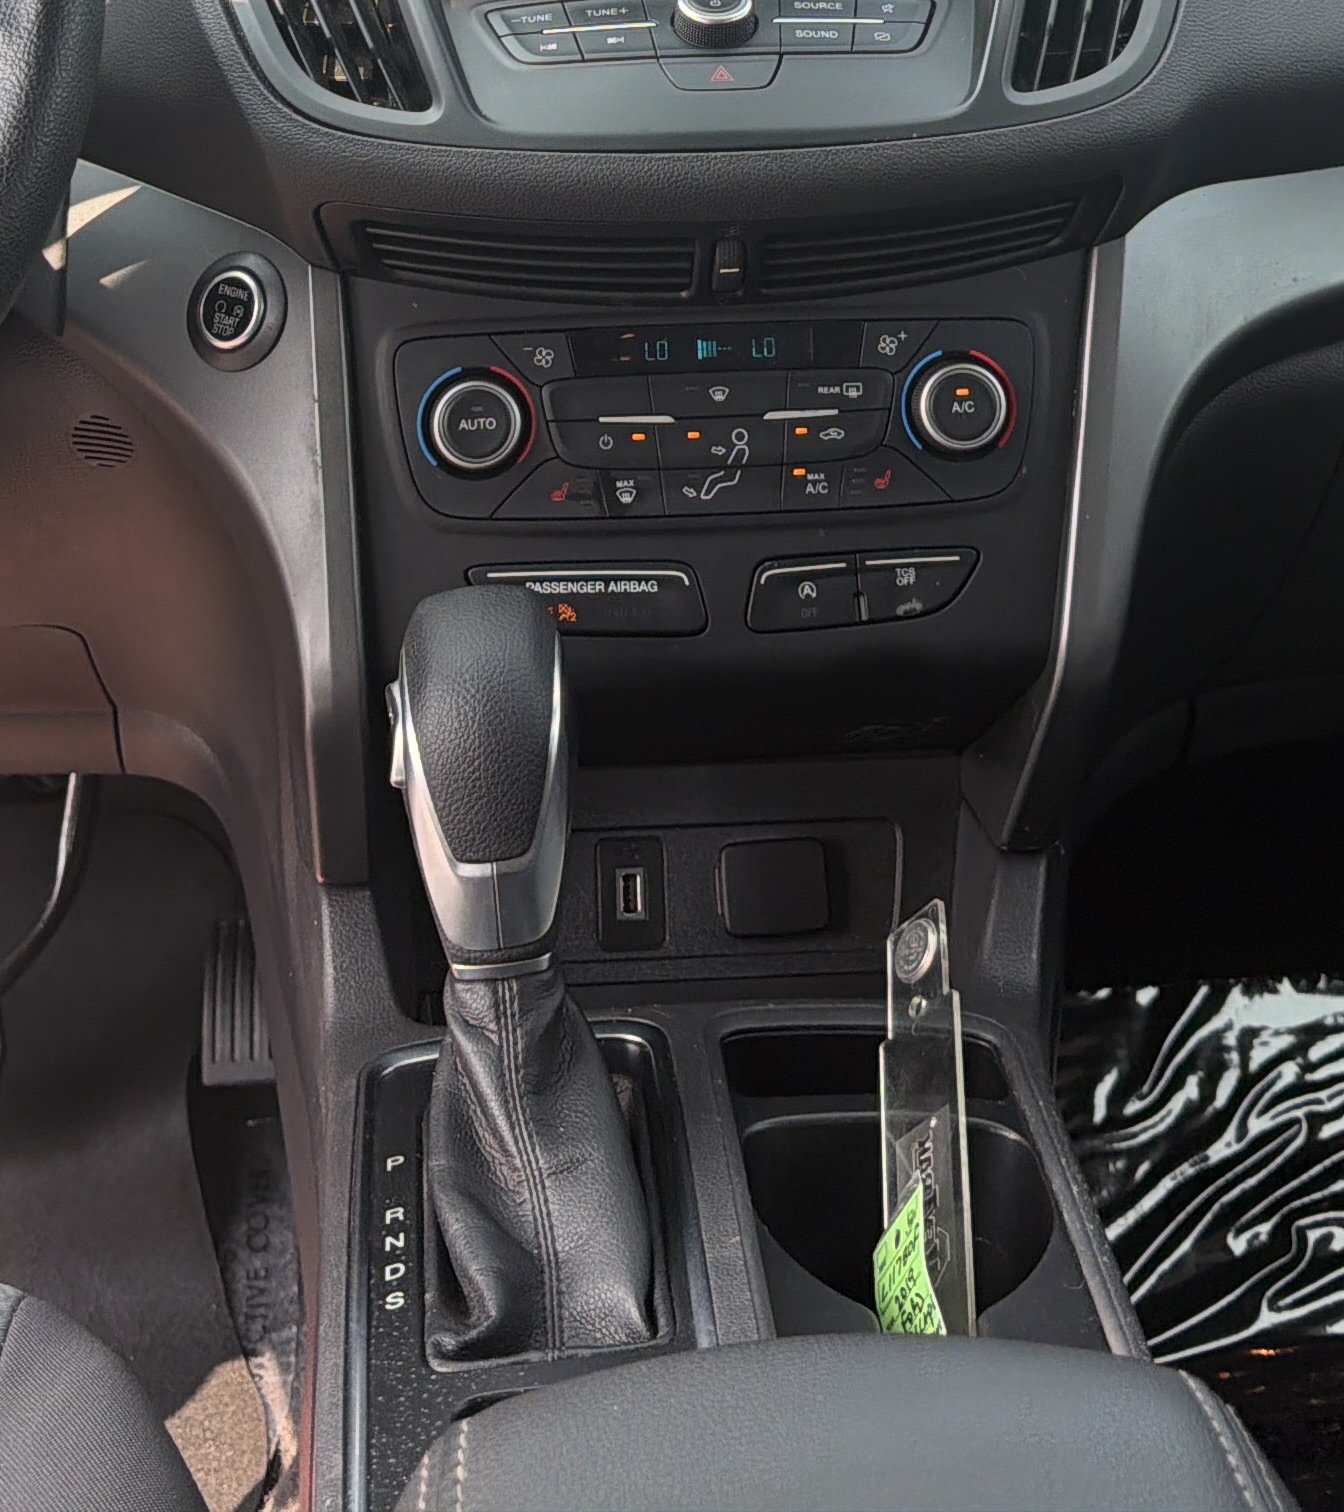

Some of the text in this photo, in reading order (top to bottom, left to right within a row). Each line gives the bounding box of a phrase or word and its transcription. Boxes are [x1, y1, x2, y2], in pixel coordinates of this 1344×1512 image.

[794, 1, 843, 10] SOURCE
[795, 29, 839, 39] SOUND
[218, 283, 249, 302] ENGINE
[213, 312, 240, 327] START
[212, 324, 235, 336] STOP
[818, 386, 841, 394] REAR
[951, 401, 975, 414] A/C
[459, 417, 497, 431] AUTO
[807, 473, 825, 481] MAX
[616, 480, 634, 488] MAX
[806, 483, 829, 495] A/C
[895, 568, 916, 577] TCS
[608, 580, 658, 593] AIRBAG
[896, 576, 916, 586] OFF
[386, 1155, 404, 1172] P
[385, 1207, 404, 1224] R
[385, 1232, 404, 1251] N
[384, 1263, 406, 1281] D
[384, 1291, 405, 1310] S
